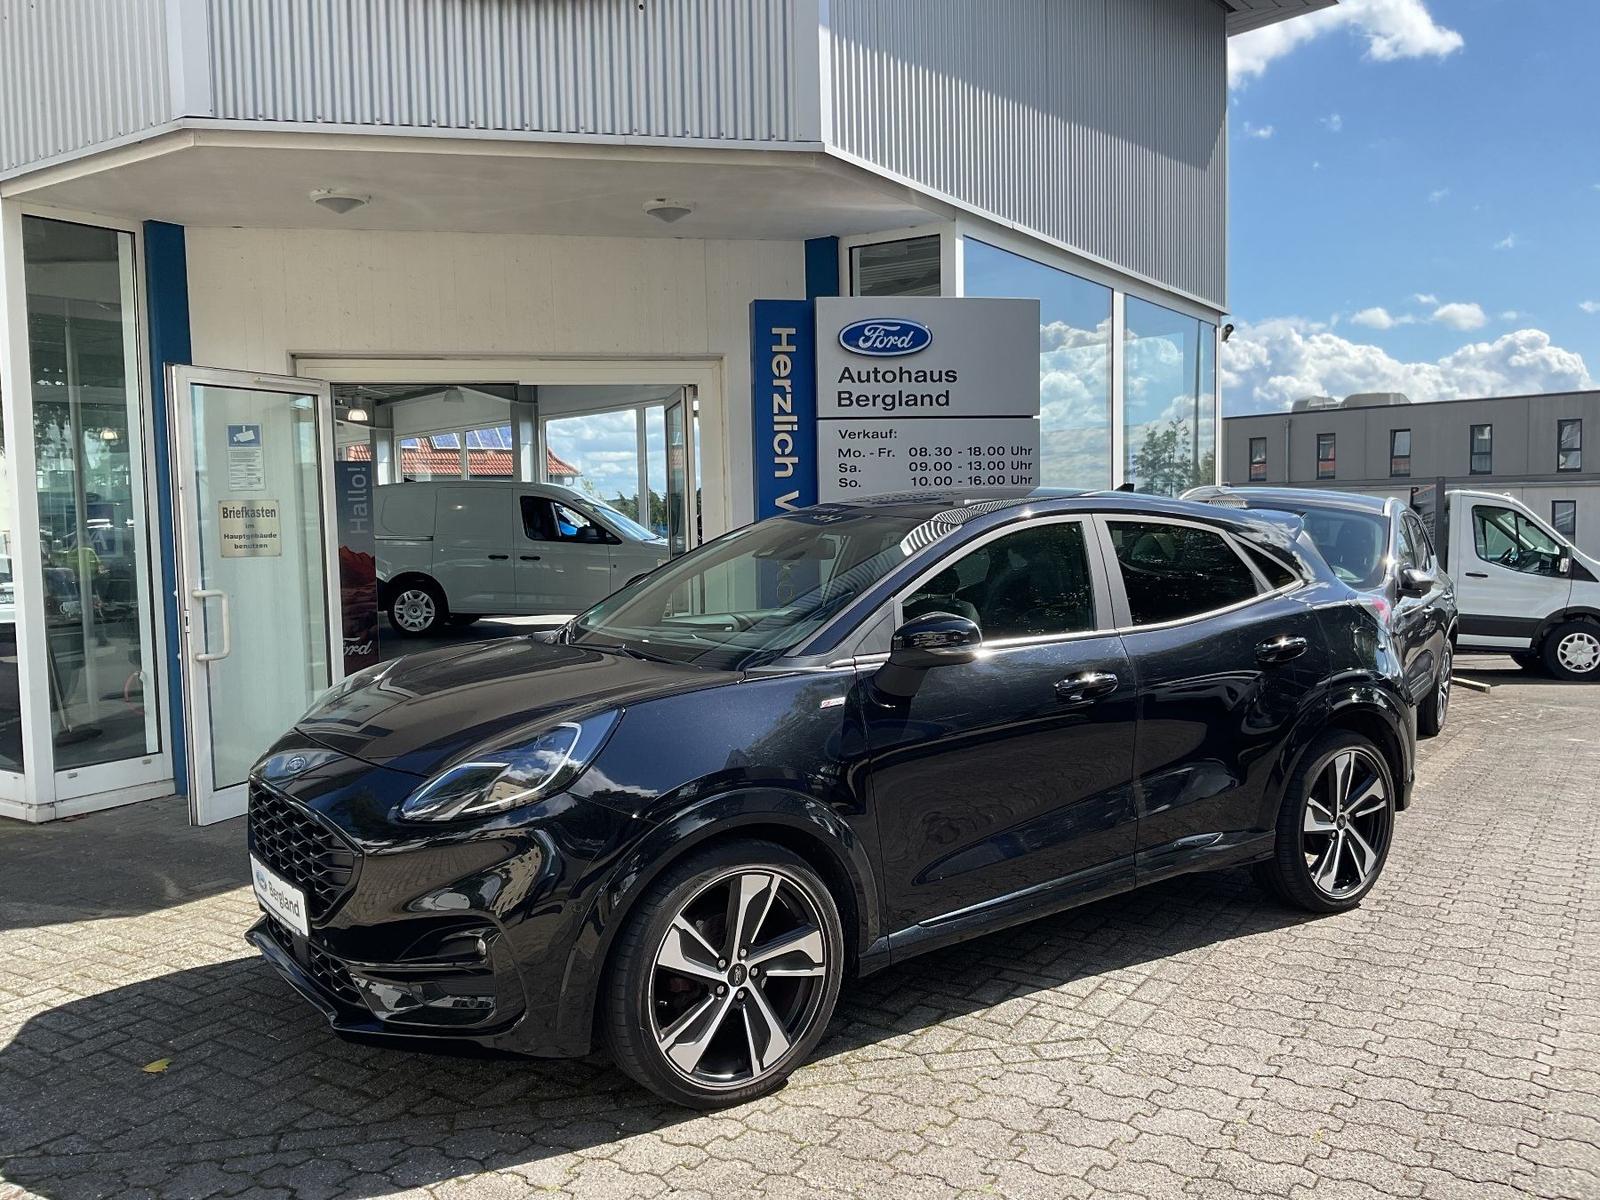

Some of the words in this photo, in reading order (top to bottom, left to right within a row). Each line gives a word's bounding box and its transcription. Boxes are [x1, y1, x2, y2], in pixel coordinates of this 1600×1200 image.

[858, 324, 914, 349] Ford
[838, 366, 958, 384] Autohaus
[771, 327, 800, 478] Herzlich
[837, 390, 950, 411] Bergland
[838, 429, 897, 440] Verkauf:
[908, 446, 953, 457] 08.30
[967, 446, 1006, 457] 18.00
[1010, 446, 1033, 456] Uhr
[838, 463, 862, 473] Sa.
[908, 461, 953, 472] 09.00
[967, 460, 1006, 471] 13.00
[1010, 460, 1033, 471] Uhr
[838, 477, 862, 488] So.
[911, 476, 953, 487] 10.00
[967, 475, 1006, 486] 16.00
[1010, 474, 1033, 485] Uhr
[347, 467, 369, 534] Hallo!
[222, 506, 277, 519] Briefkasten
[267, 880, 301, 918] Bergland
